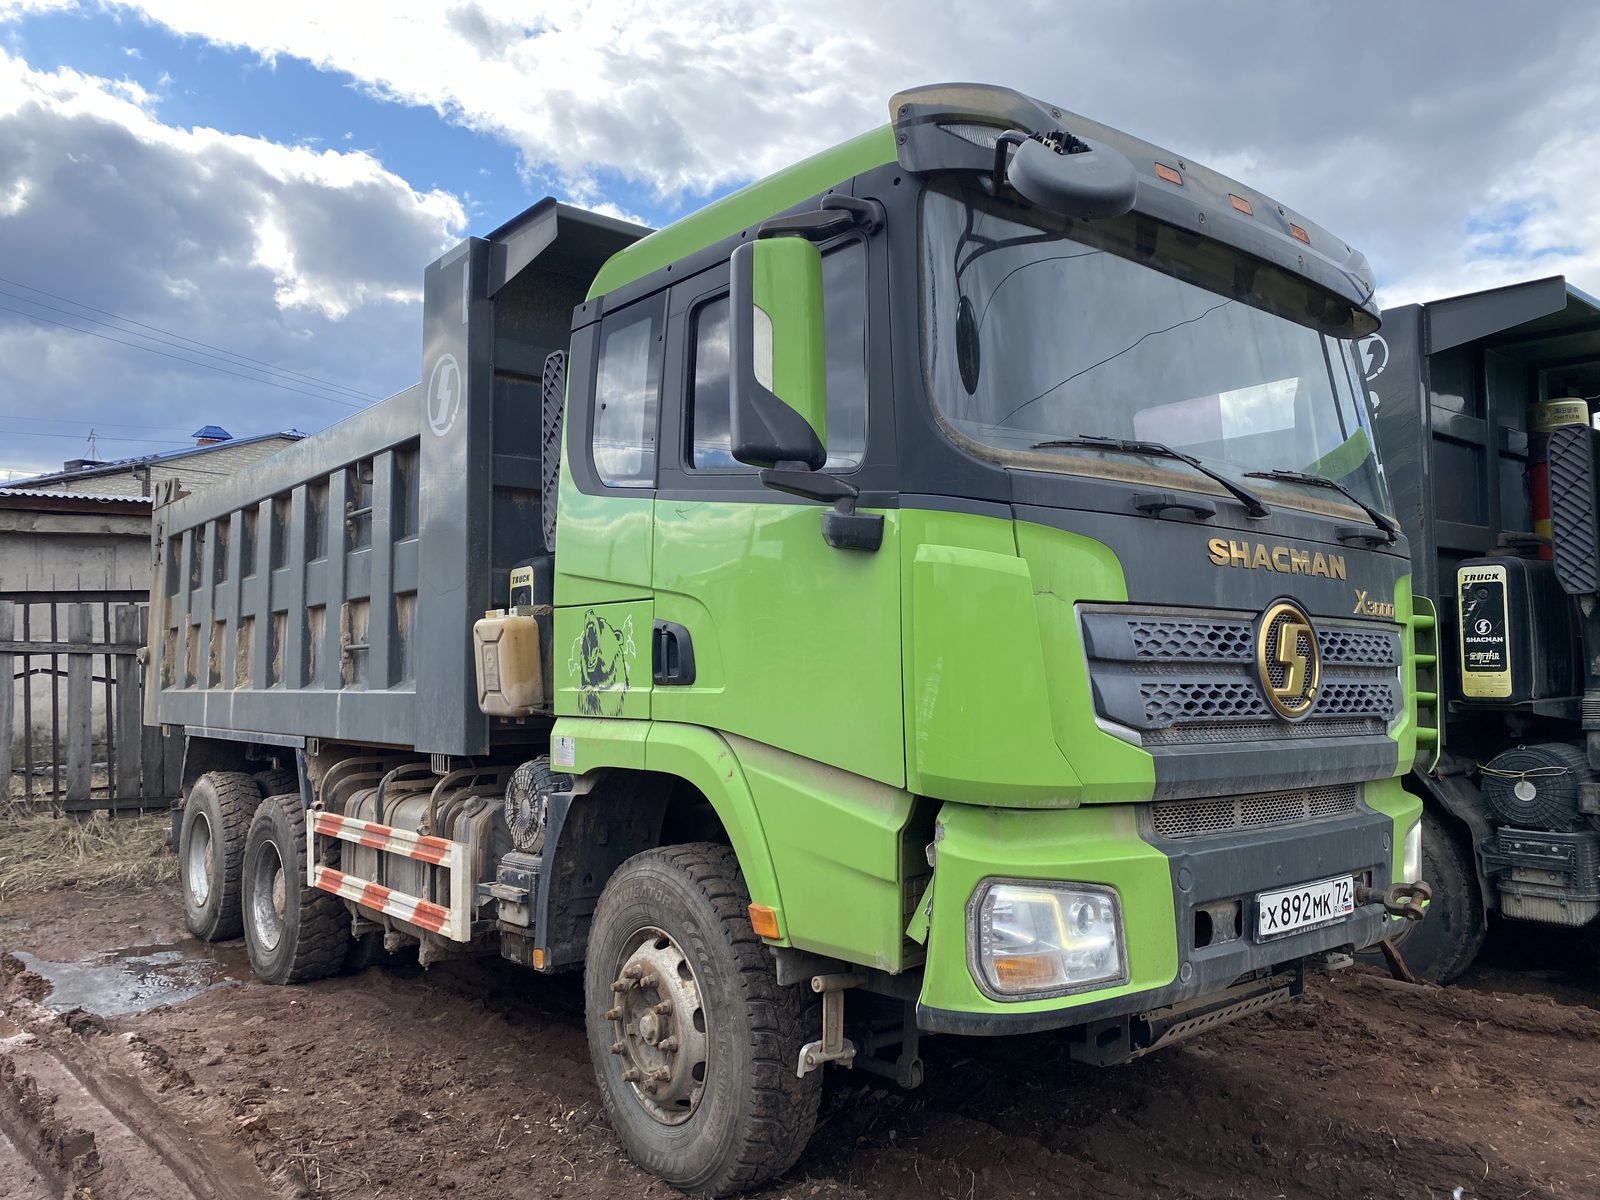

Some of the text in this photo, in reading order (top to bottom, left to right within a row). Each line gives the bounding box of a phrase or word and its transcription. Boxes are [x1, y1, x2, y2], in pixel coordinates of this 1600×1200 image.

[1207, 537, 1347, 580] SHACMAN
[512, 574, 531, 585] TRUCK
[1463, 573, 1500, 581] TRUCK
[1353, 589, 1395, 618] X3000
[1334, 881, 1349, 904] 72
[1334, 905, 1345, 914] RUS
